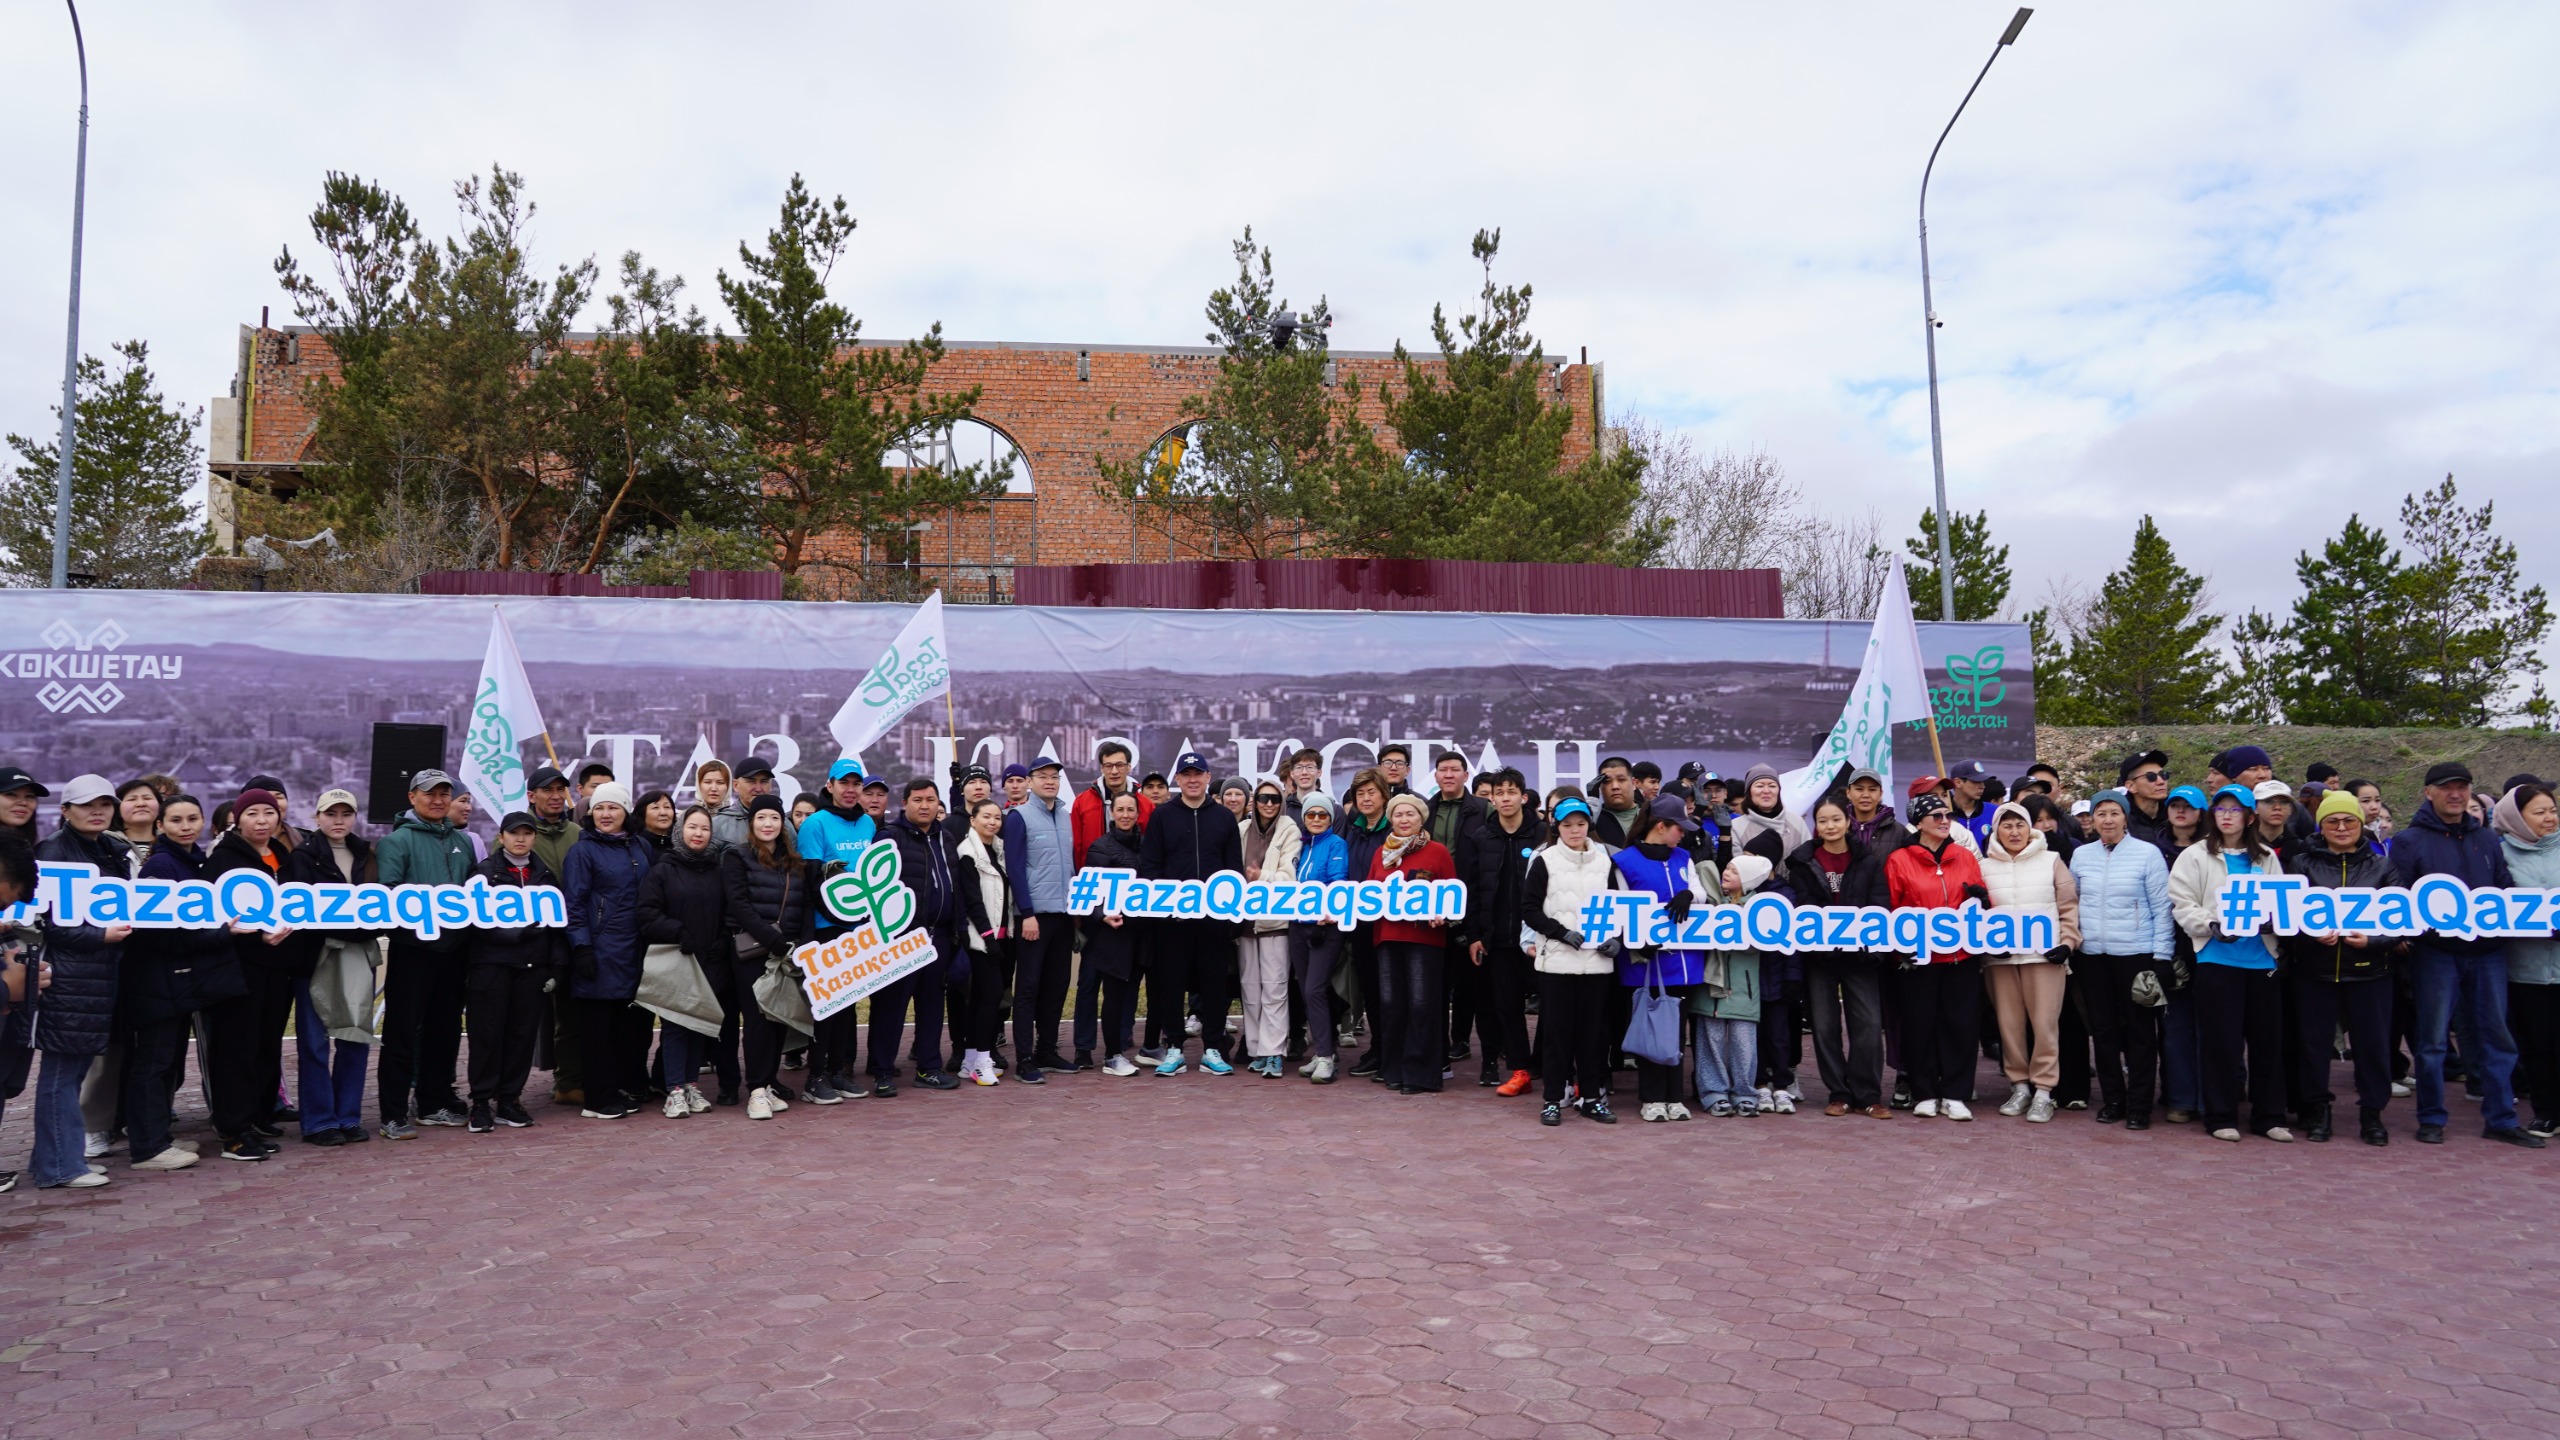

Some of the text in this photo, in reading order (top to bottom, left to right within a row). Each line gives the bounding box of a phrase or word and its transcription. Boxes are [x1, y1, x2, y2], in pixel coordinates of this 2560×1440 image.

[1927, 686, 1971, 714] аза
[835, 840, 864, 851] unicef
[1070, 871, 1464, 926] #TazaQazaqstan
[1581, 895, 2053, 958] #TazaQazaqstan
[798, 927, 878, 977] Таза
[809, 931, 928, 1002] Қазақстан
[914, 950, 934, 966] АКЦИЯ
